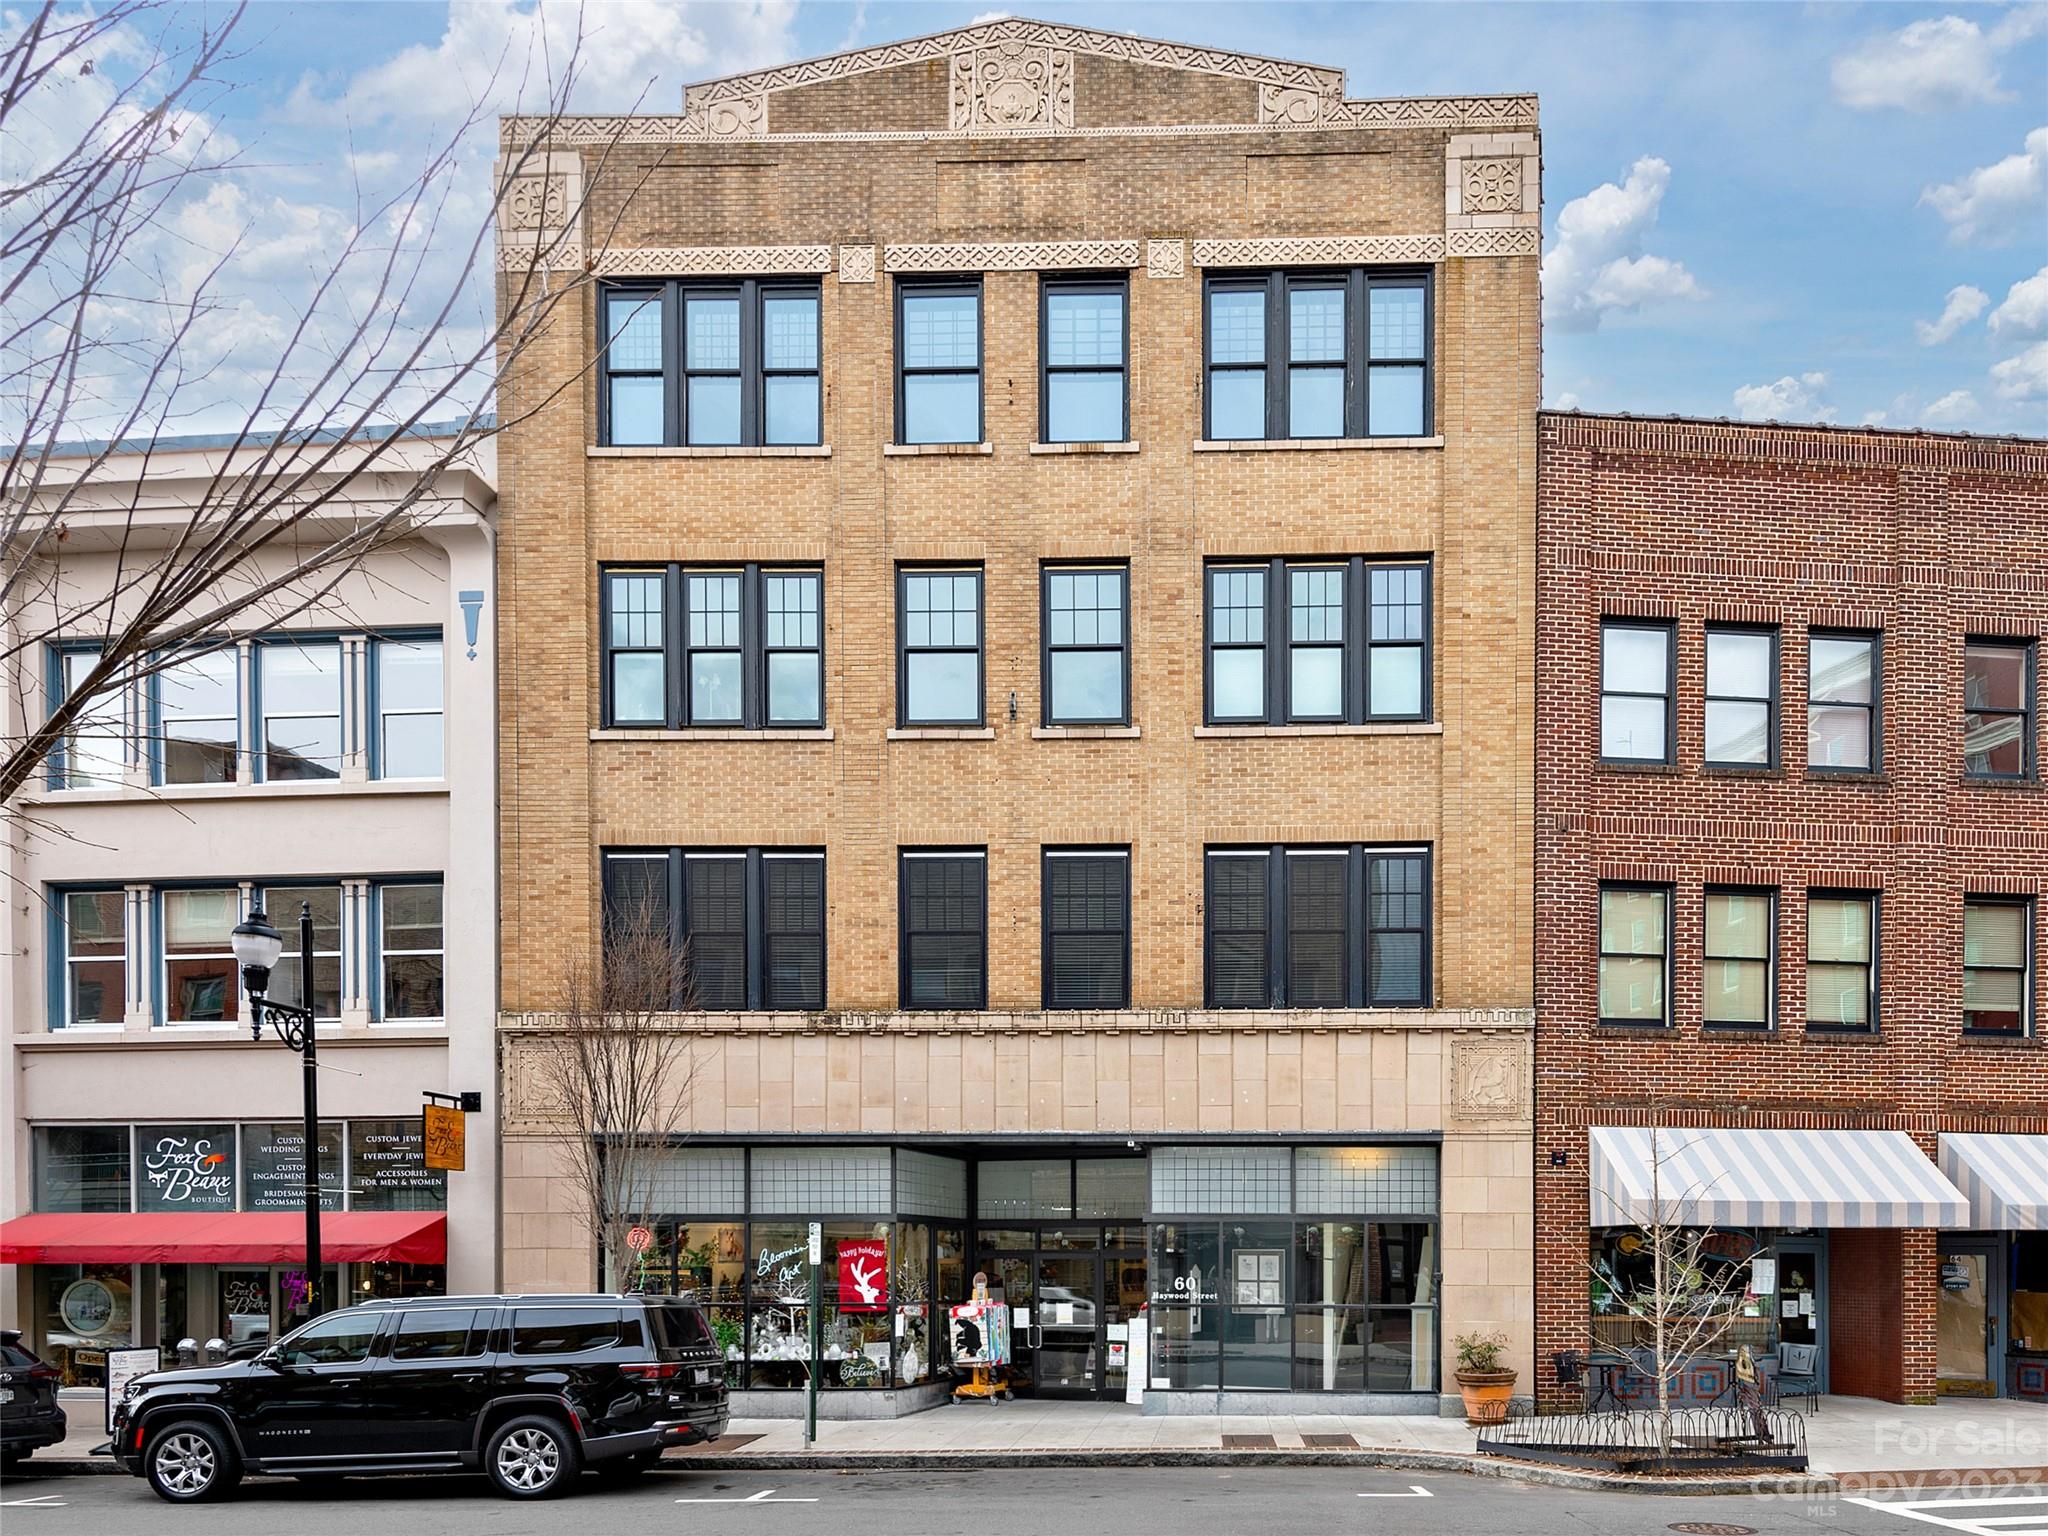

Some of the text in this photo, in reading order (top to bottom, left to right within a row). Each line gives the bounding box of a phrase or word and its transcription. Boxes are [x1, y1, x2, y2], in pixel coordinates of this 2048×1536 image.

[276, 1137, 306, 1145] CUSTO
[365, 1135, 423, 1144] CUSTOM JEWE
[145, 1137, 196, 1169] Fox
[363, 1152, 403, 1160] EVERYDAY
[375, 1170, 428, 1178] ACCESSORIES
[161, 1167, 232, 1201] Beaux
[254, 1199, 306, 1207] GROOMSMEN
[1174, 1276, 1196, 1291] 60
[1151, 1291, 1219, 1301] Haywood Street
